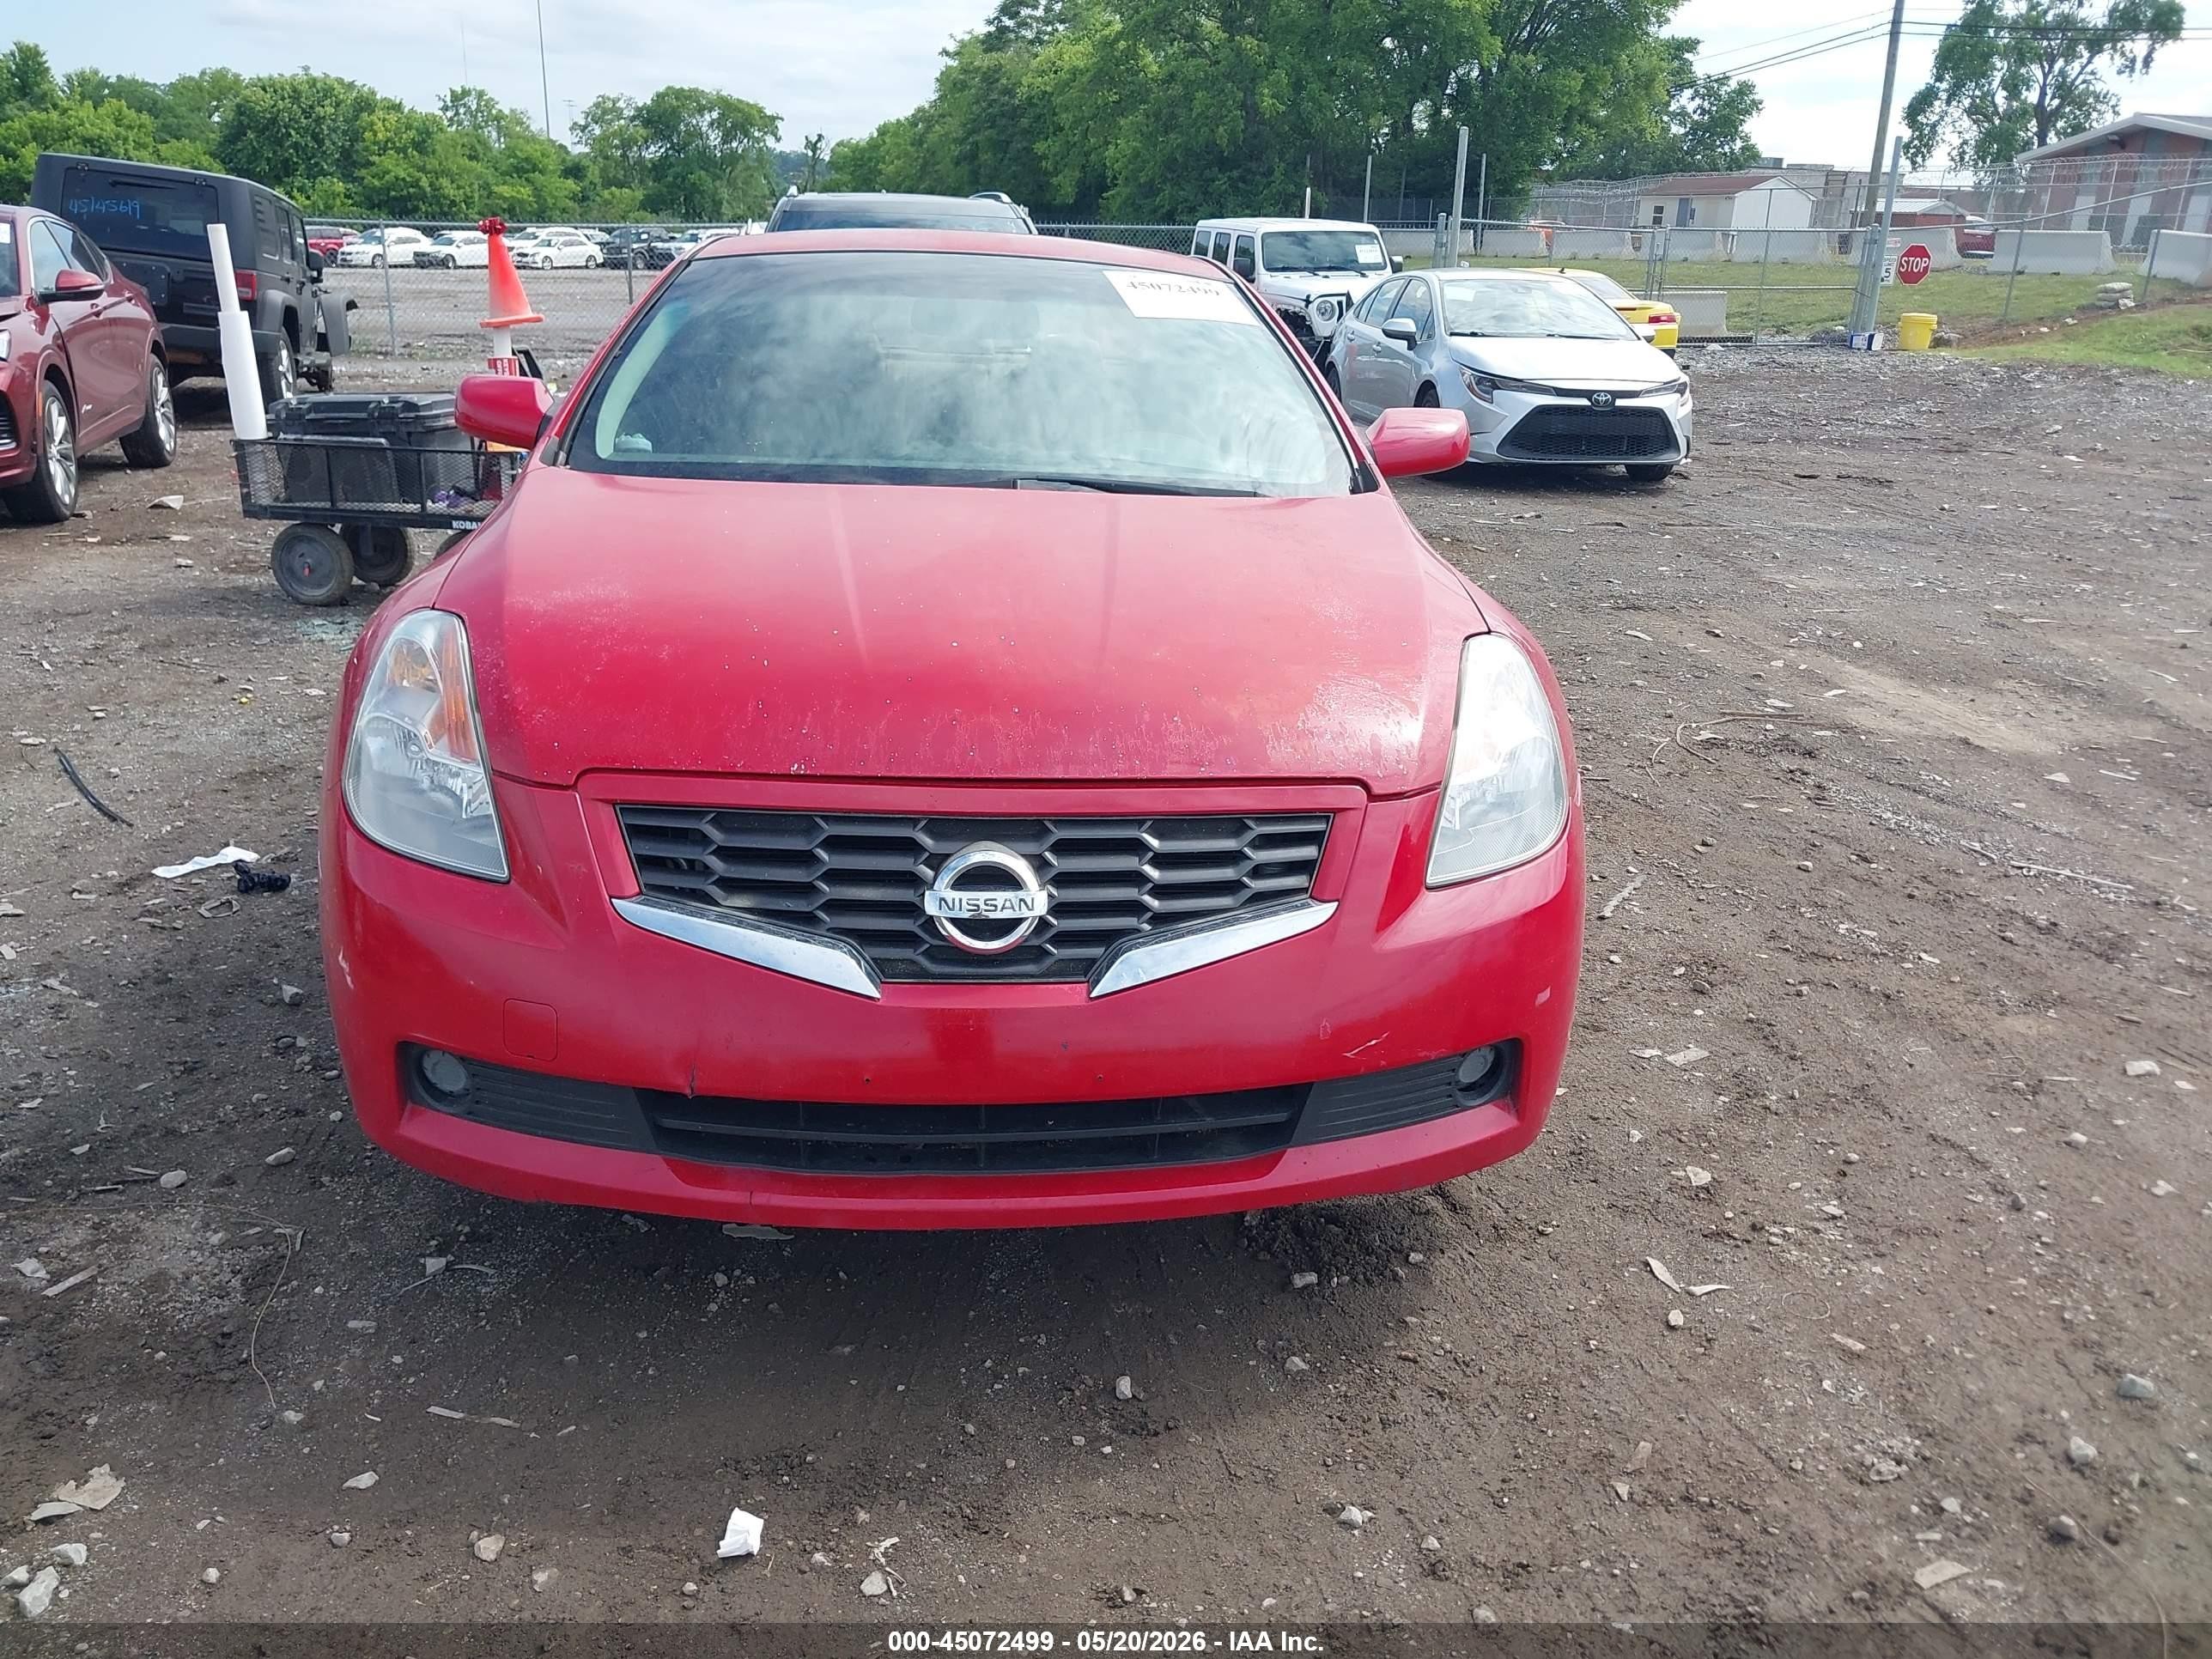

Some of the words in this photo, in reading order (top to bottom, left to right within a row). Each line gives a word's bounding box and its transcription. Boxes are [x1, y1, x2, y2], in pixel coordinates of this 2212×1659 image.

[1899, 257, 1929, 272] STOP
[1884, 267, 1892, 279] 5
[939, 896, 1035, 912] NISSAN
